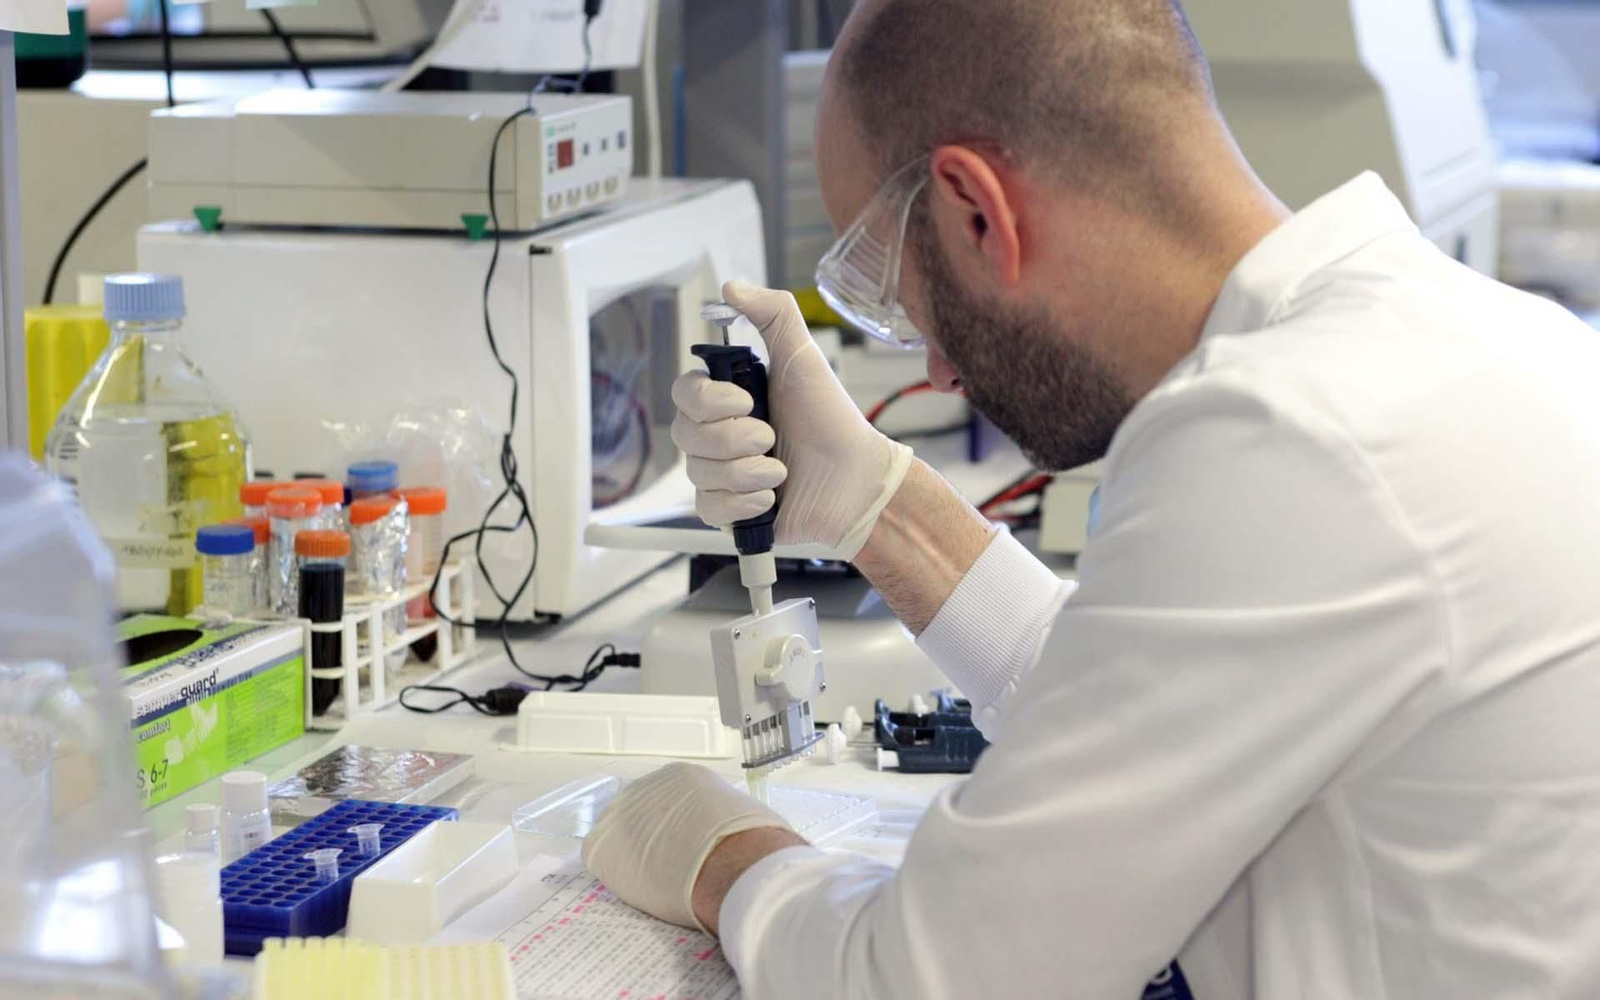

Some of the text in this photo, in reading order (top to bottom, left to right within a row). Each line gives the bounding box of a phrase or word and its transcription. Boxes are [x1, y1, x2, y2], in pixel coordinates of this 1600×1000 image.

[136, 719, 170, 743] comfort
[136, 758, 168, 789] S 6-7
